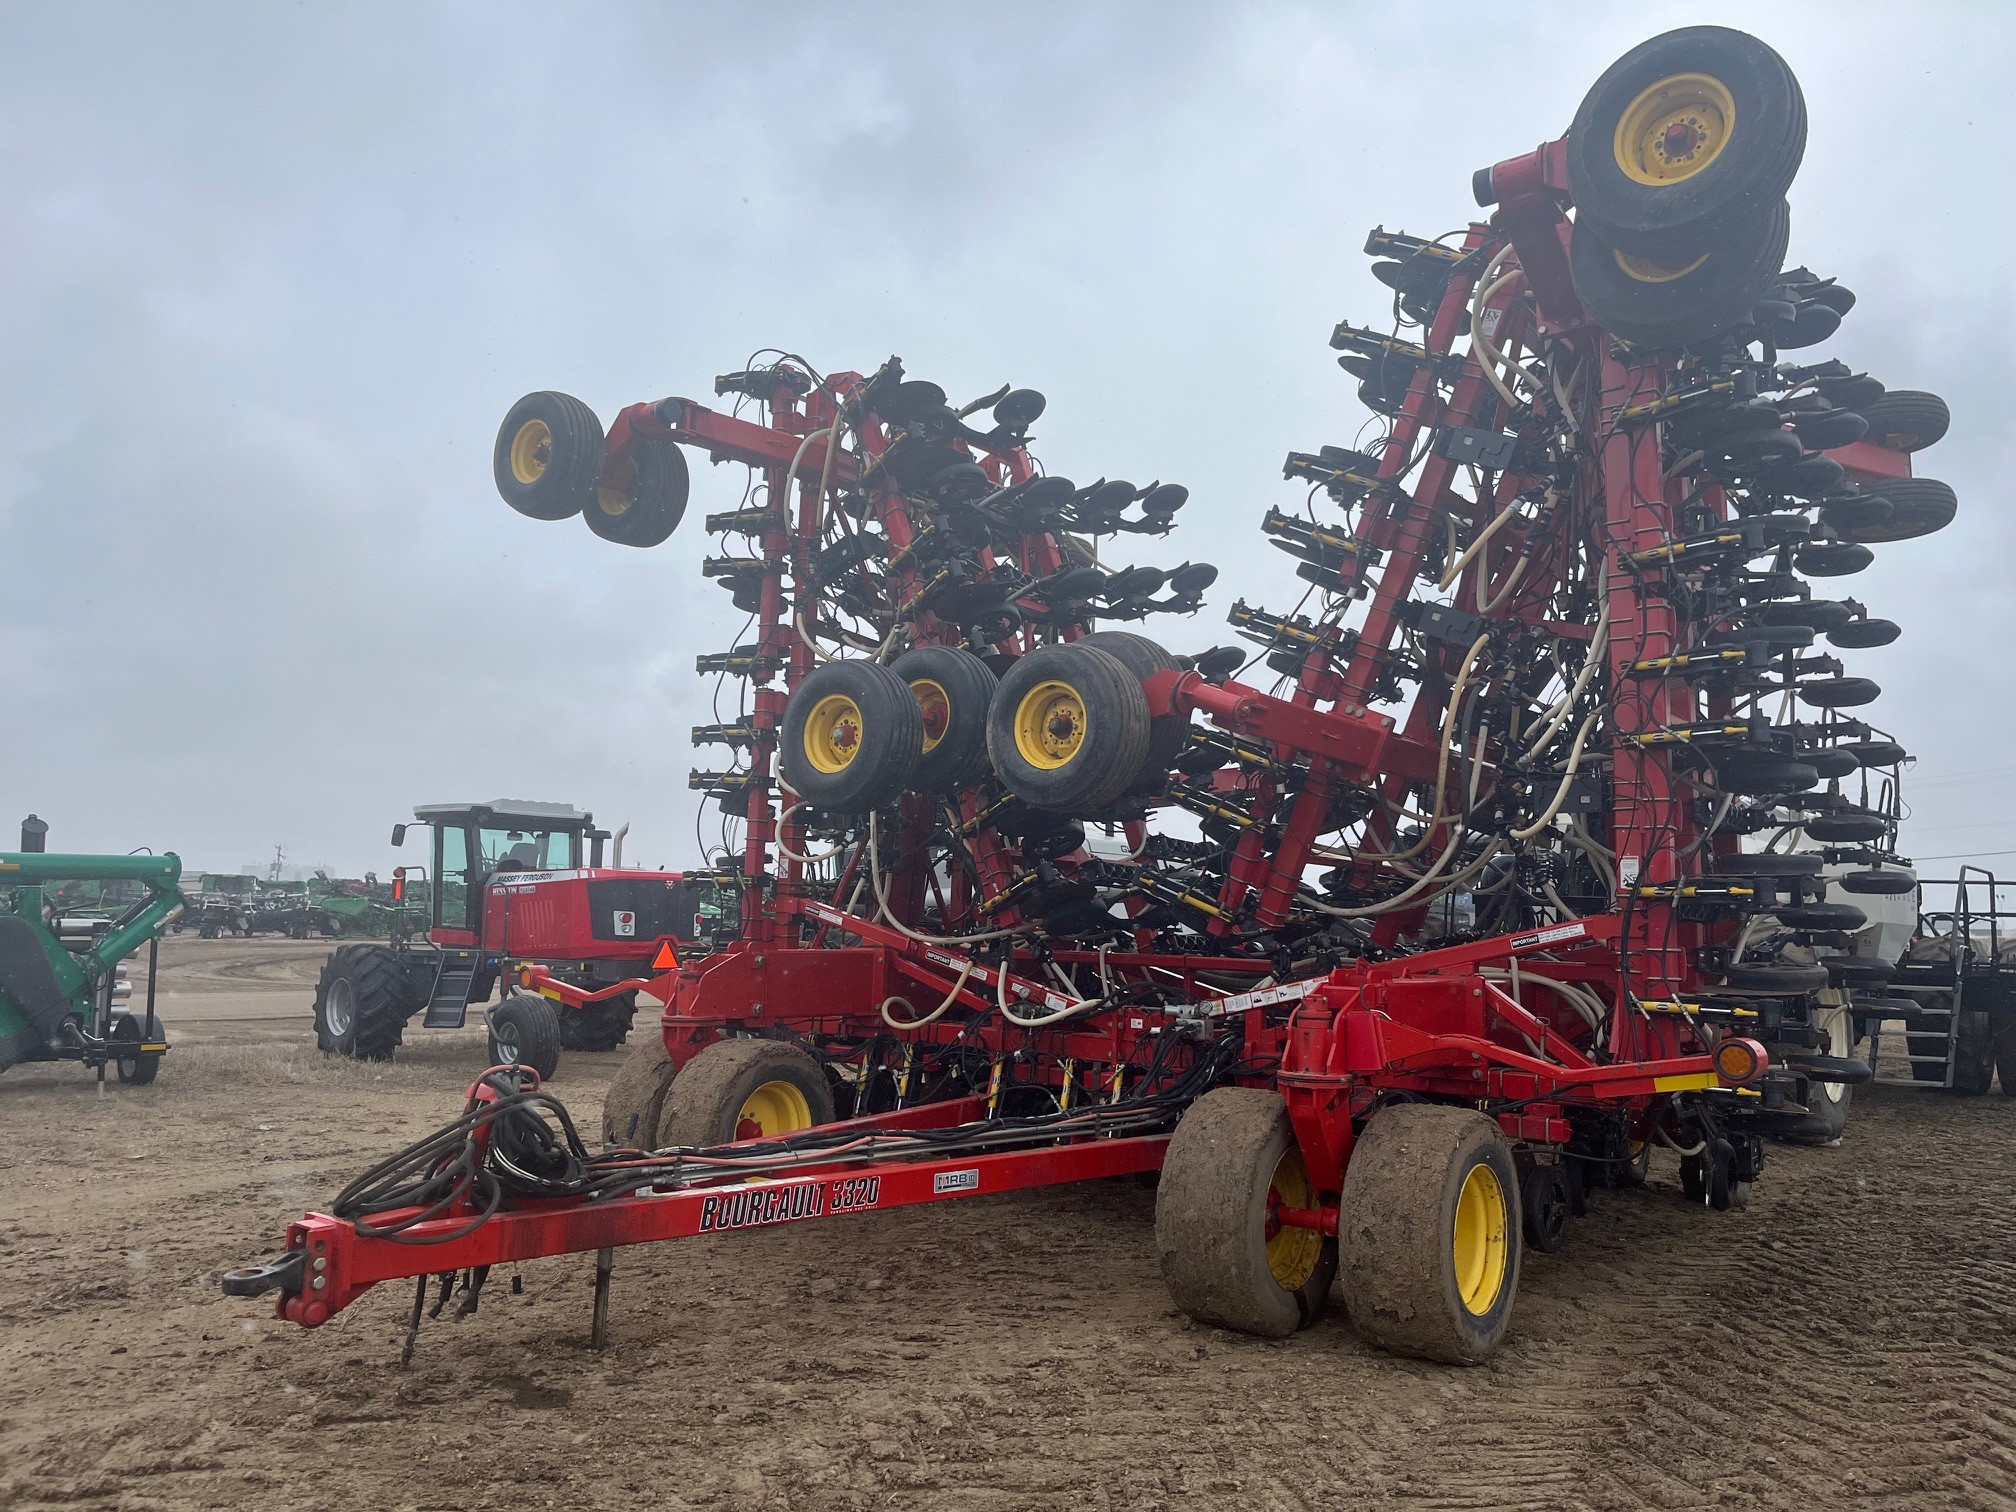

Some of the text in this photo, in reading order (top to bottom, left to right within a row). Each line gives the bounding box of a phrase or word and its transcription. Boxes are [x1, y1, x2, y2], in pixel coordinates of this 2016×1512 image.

[497, 873, 555, 883] MASSEY FERGUSON
[1512, 936, 1538, 947] IMPORTANT
[926, 951, 950, 965] IMPORTANT
[699, 1176, 881, 1233] BOURGAULT 3320
